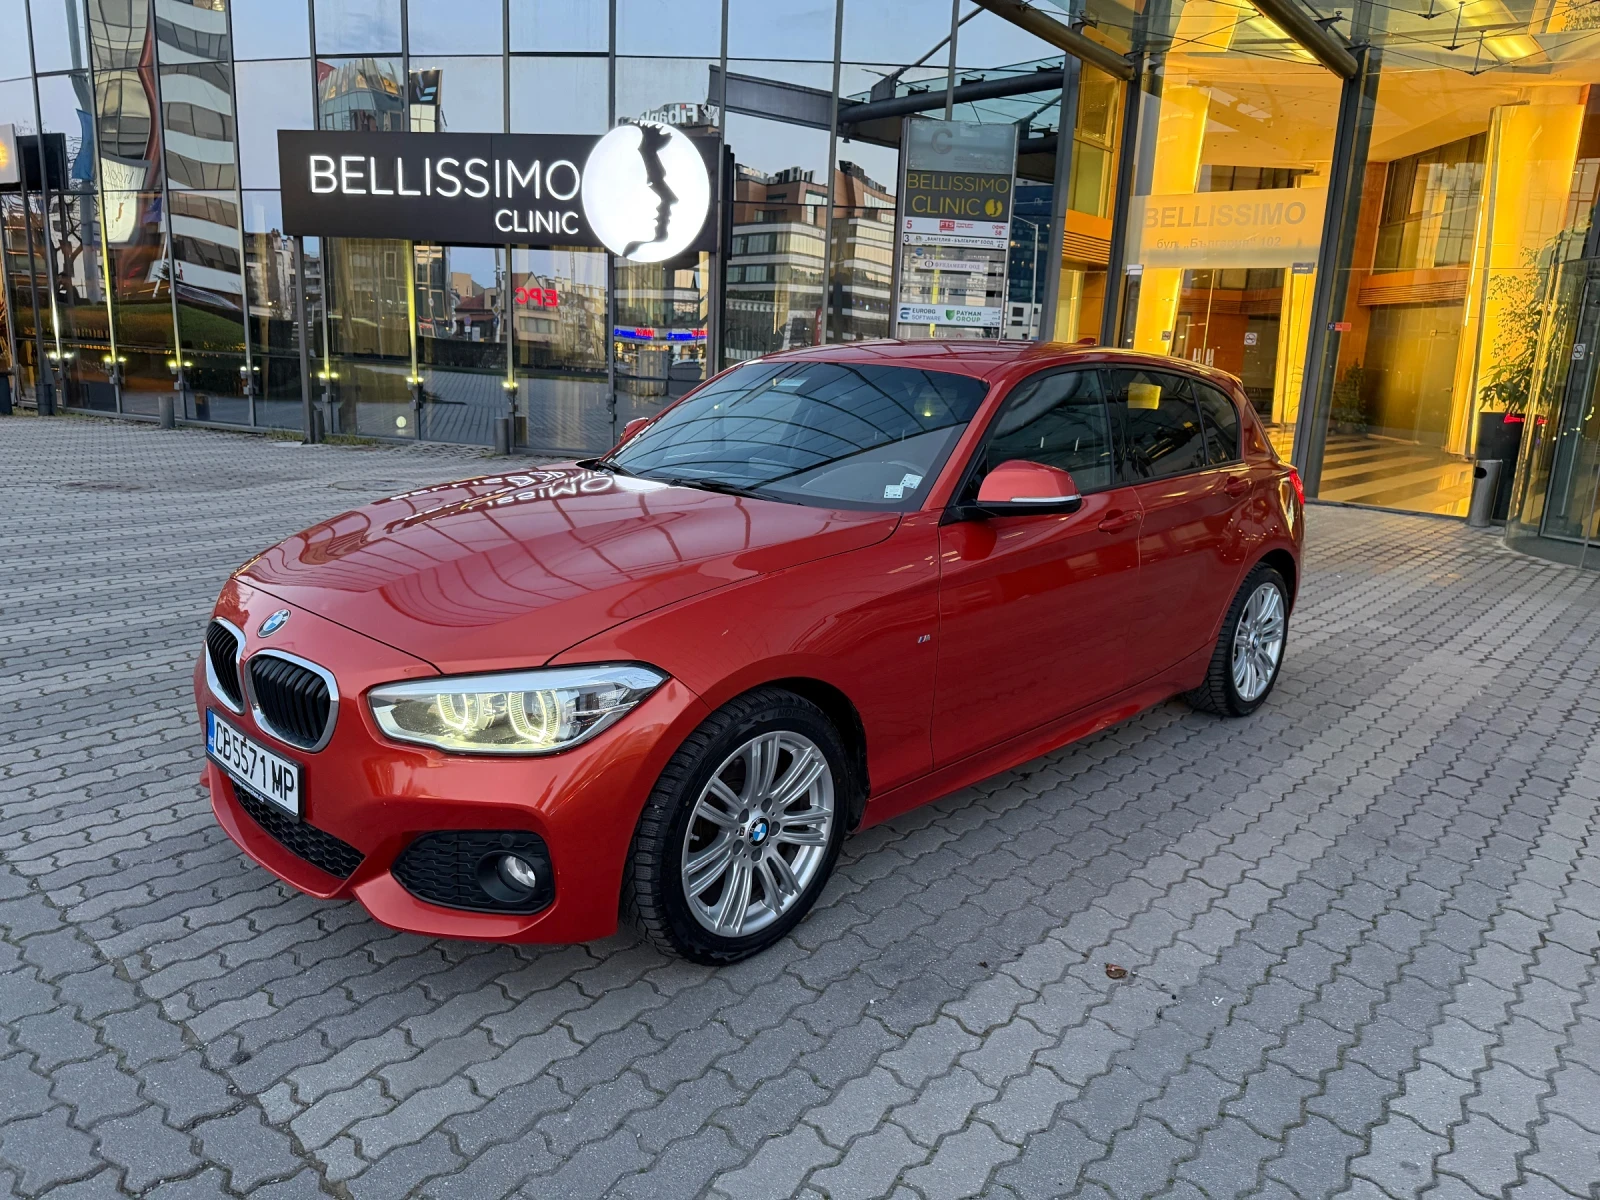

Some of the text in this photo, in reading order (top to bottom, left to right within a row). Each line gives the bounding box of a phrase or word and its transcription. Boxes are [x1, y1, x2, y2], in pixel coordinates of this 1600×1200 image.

[308, 154, 580, 201] BELLISSIMO
[907, 173, 1010, 194] BELLISSIMO
[912, 195, 981, 215] CLINIC
[494, 209, 580, 236] CLINIC
[1144, 202, 1307, 229] BELLISSIMO
[906, 219, 913, 230] 5
[940, 221, 954, 229] FTS
[904, 235, 910, 243] 3
[1260, 236, 1282, 247] 102
[911, 314, 941, 322] SOFTWARE
[912, 307, 936, 315] EUROBG
[215, 721, 267, 789] CB5571
[271, 762, 295, 802] MP
